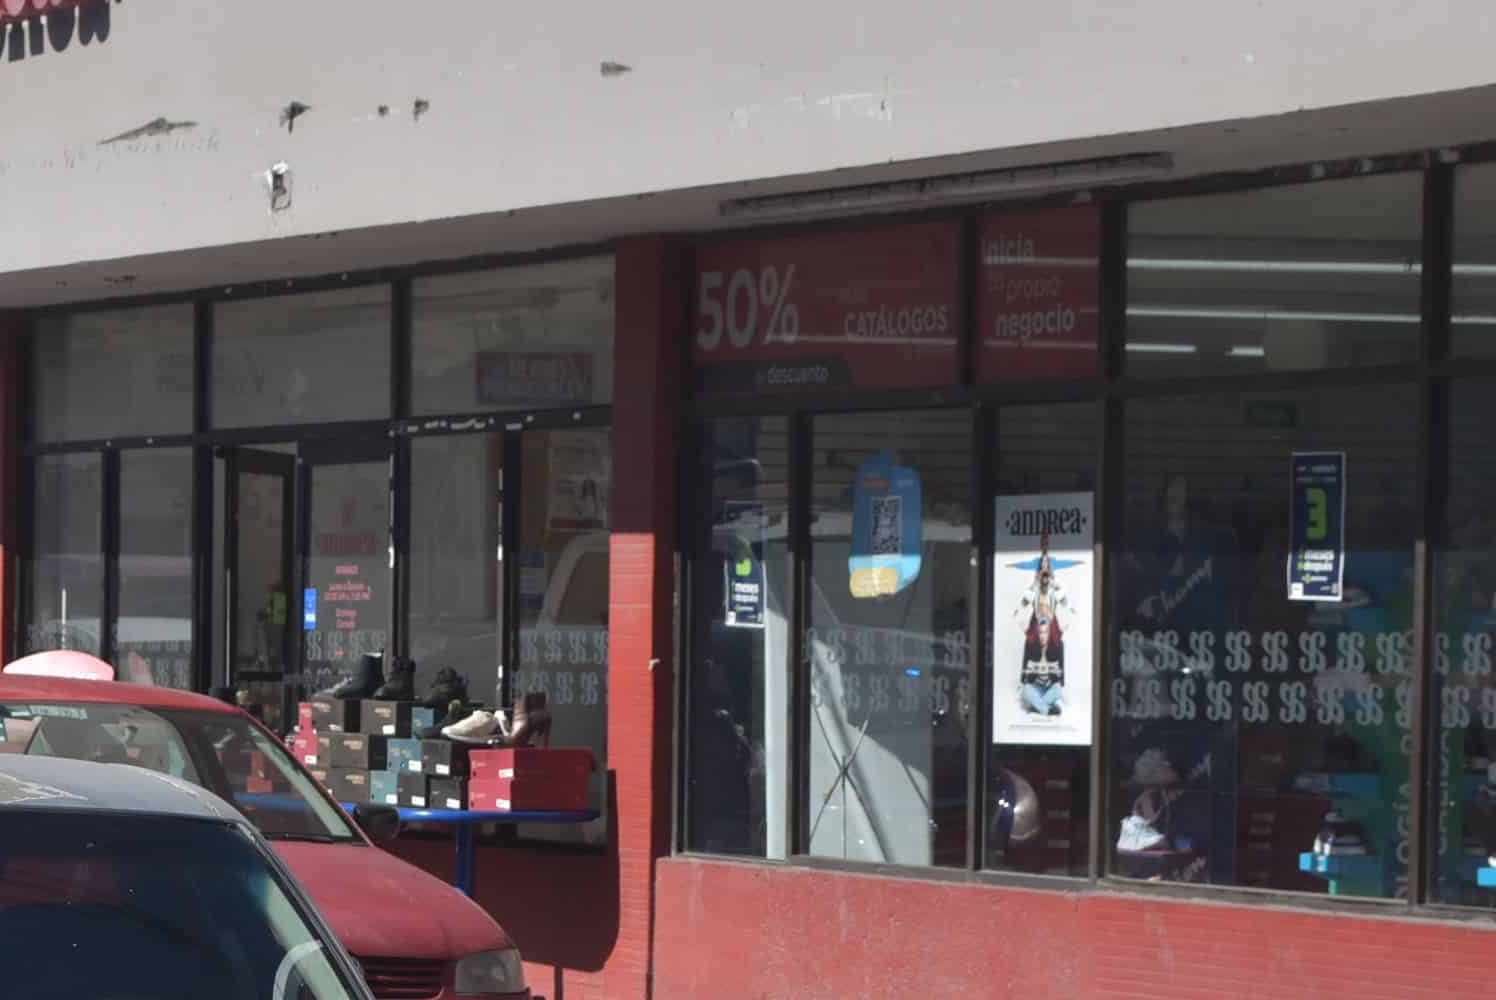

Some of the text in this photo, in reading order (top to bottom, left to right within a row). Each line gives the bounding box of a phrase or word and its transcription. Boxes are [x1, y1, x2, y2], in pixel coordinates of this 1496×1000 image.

[696, 263, 800, 351] 50%
[994, 303, 1076, 342] negocio
[1304, 487, 1327, 541] 3
